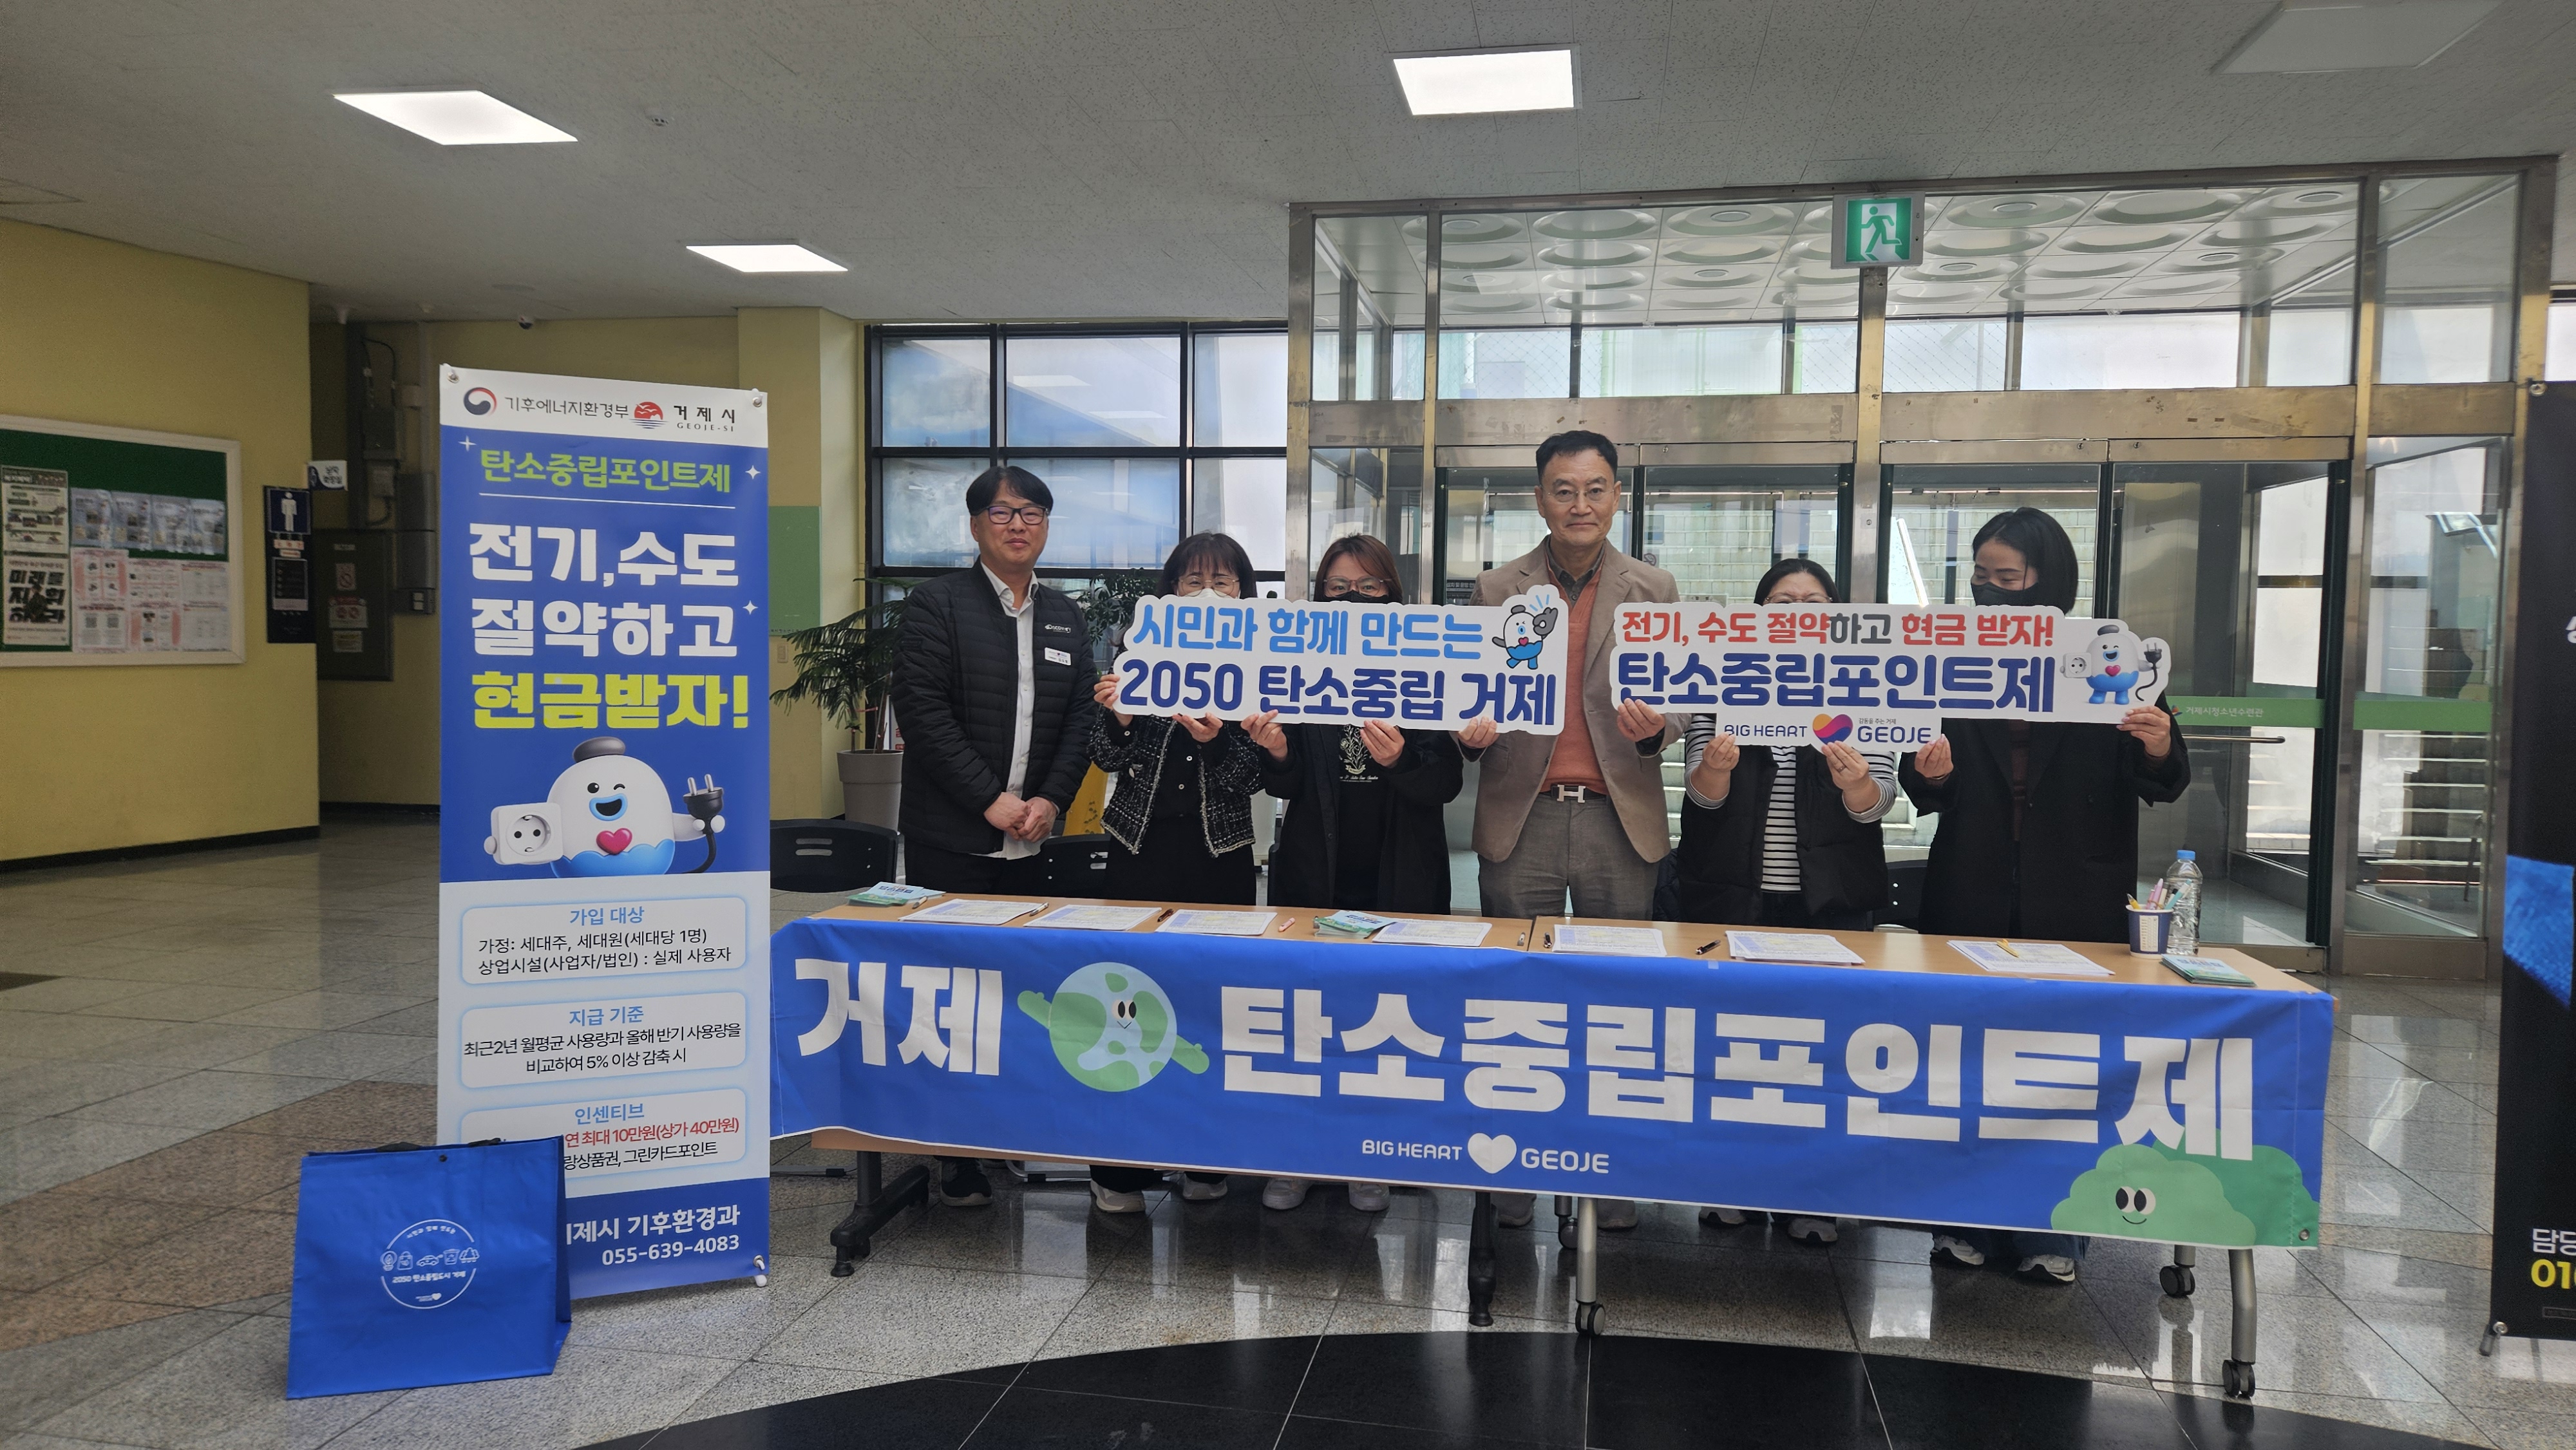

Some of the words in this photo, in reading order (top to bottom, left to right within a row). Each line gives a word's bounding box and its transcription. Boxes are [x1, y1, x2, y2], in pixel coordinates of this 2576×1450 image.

[505, 396, 629, 419] 기후에너지환경부
[677, 422, 734, 432] GEOJE-SI
[481, 449, 730, 493] 탄소중립포인트제
[471, 598, 737, 657] 절약하고
[1133, 603, 1258, 653] 시민과
[1267, 607, 1349, 655] 함께
[1361, 612, 1482, 660] 만드는
[1622, 611, 1689, 646] 전기,
[1698, 612, 1757, 643] 수도
[1767, 612, 1892, 644] 절약하고
[1902, 613, 1967, 646] 현금
[1977, 614, 2054, 647] 받자!
[1120, 658, 1244, 711] 2050
[1258, 663, 1444, 721] 탄소중립
[1459, 672, 1556, 726] 거제
[1618, 652, 2056, 713] 탄소중립포인트제
[471, 670, 749, 729] 현금받자!
[1724, 724, 1750, 737] BIG
[1754, 724, 1808, 739] HEART
[1857, 726, 1931, 744] GEOJE
[569, 907, 604, 926] 가입
[610, 905, 645, 925] 대상
[478, 937, 515, 955] 가정:
[520, 934, 572, 953] 세대주,
[577, 929, 676, 950] 세대원(세대당
[679, 927, 707, 944] 1명)
[478, 951, 638, 976] 상업시설(사업자/법인)
[653, 948, 683, 965] 실제
[687, 946, 732, 964] 사용자
[569, 1008, 604, 1027] 지급
[609, 1006, 645, 1025] 기준
[464, 1037, 518, 1057] 최근2년
[520, 1035, 565, 1054] 월평균
[566, 1030, 624, 1050] 사용량과
[687, 1022, 741, 1040] 사용량을
[526, 1055, 583, 1075] 비교하여
[586, 1055, 609, 1070] 5%
[612, 1050, 640, 1068] 이상
[643, 1048, 671, 1066] 감축
[672, 1047, 687, 1062] 시
[795, 957, 1003, 1077] 거제
[1221, 986, 2253, 1161] 탄소중립포인트제
[574, 1103, 645, 1125] 인센티브
[565, 1131, 580, 1148] 연
[582, 1129, 611, 1146] 최대
[612, 1122, 688, 1142] 10만원(상가
[690, 1117, 739, 1135] 40만원)
[623, 1142, 718, 1163] 그린카드포인트
[1361, 1139, 1394, 1156] BIG
[1398, 1142, 1463, 1160] HEART
[1521, 1148, 1609, 1174] GEOJE
[628, 1204, 741, 1236] 기후환경과
[601, 1234, 739, 1265] 055-639-4083
[2531, 1259, 2576, 1289] 01
